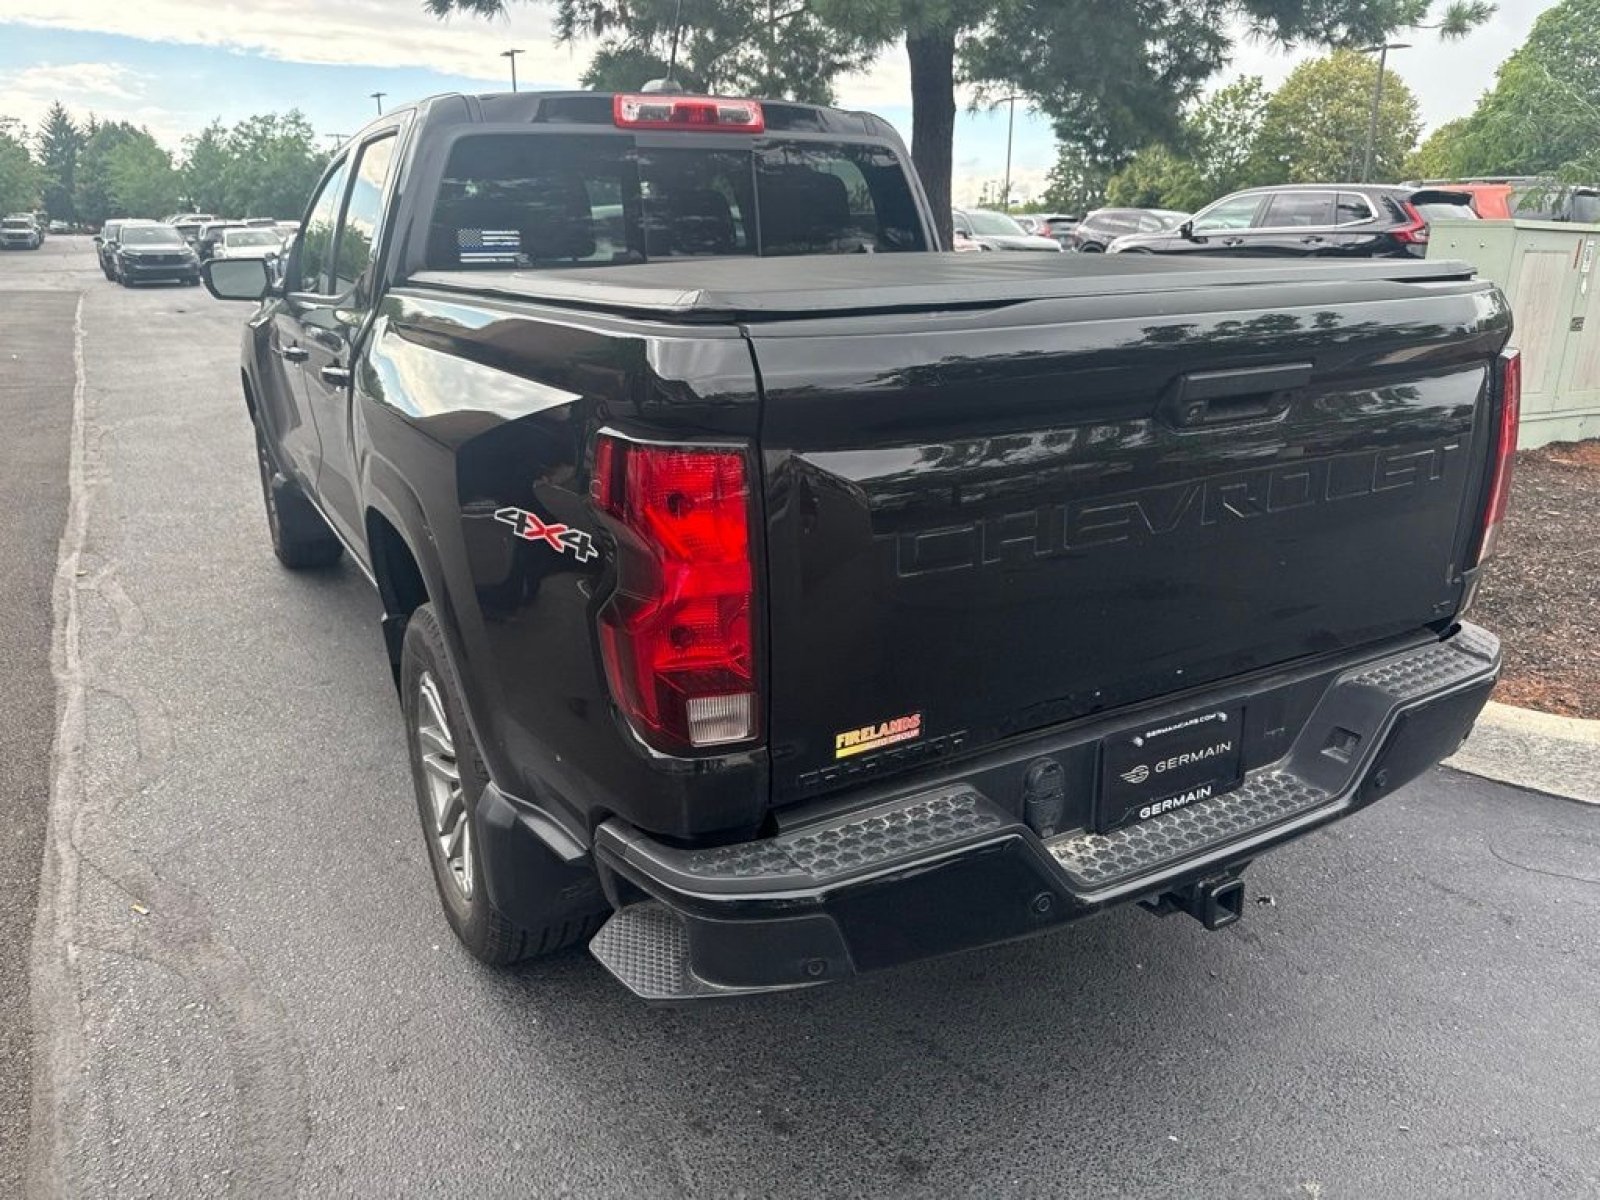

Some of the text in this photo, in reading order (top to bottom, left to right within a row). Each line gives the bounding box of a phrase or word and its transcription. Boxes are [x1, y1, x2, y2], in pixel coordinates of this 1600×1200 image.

[897, 443, 1459, 578] CHEVROLET
[836, 713, 921, 749] FIRELANDS
[1155, 741, 1232, 773] GERMAIN
[1139, 785, 1212, 820] GERMAIN
